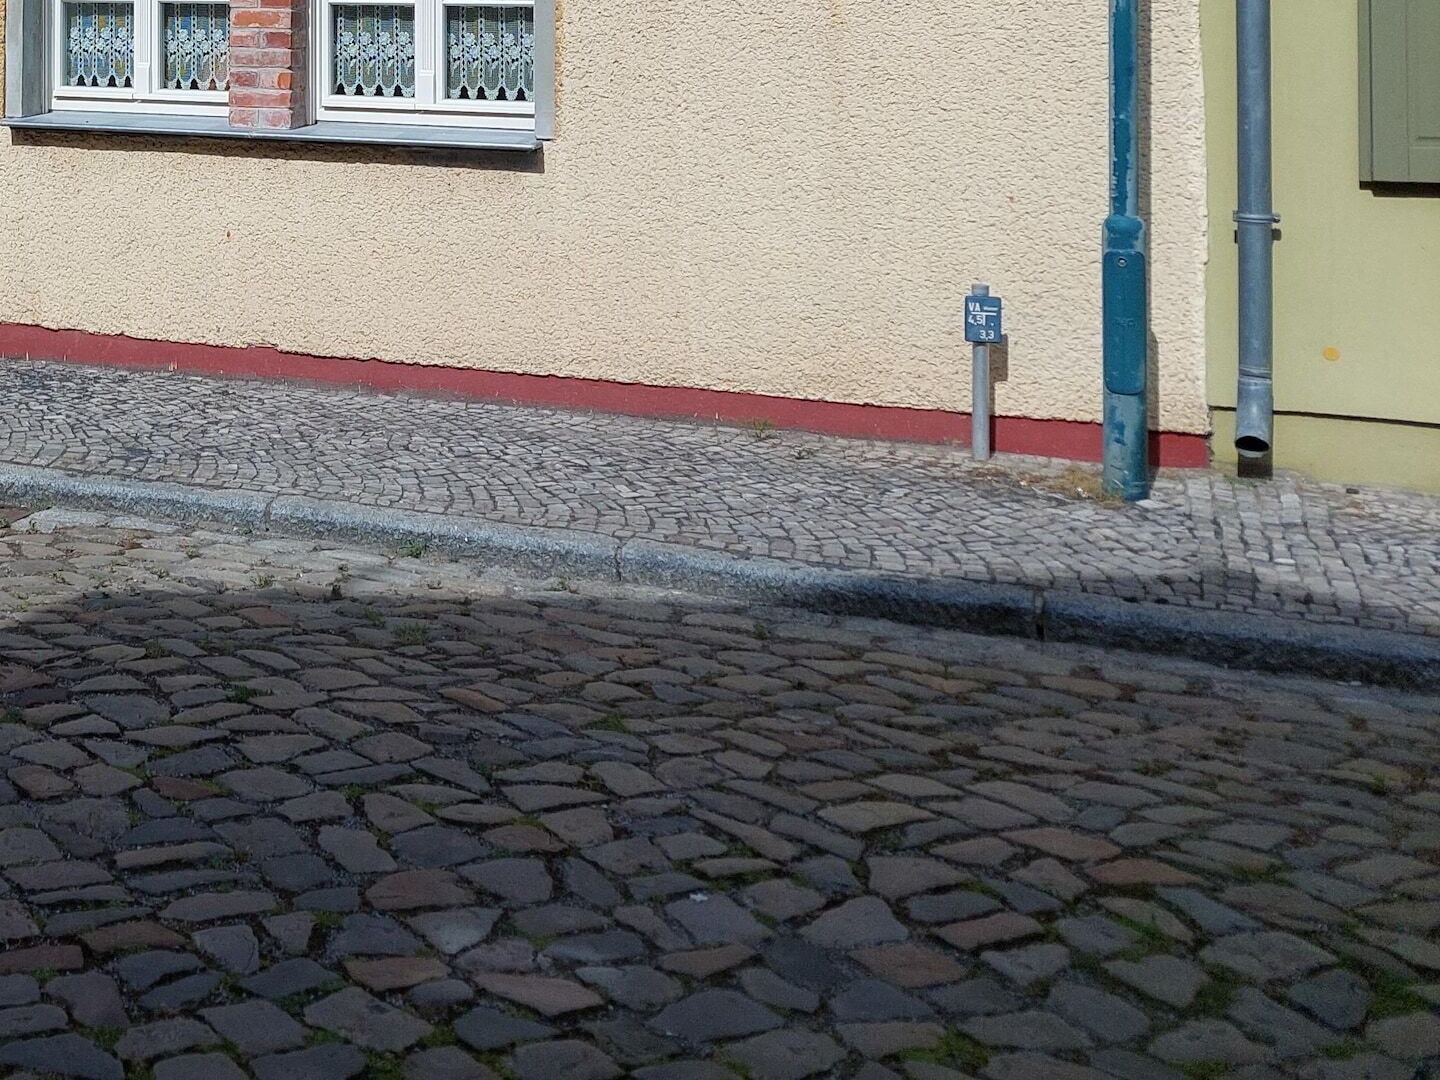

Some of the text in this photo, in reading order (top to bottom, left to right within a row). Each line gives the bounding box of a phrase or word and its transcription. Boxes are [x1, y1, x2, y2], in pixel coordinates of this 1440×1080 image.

[968, 302, 981, 312] VA
[968, 314, 983, 325] 4,5
[979, 330, 994, 341] 3,3
